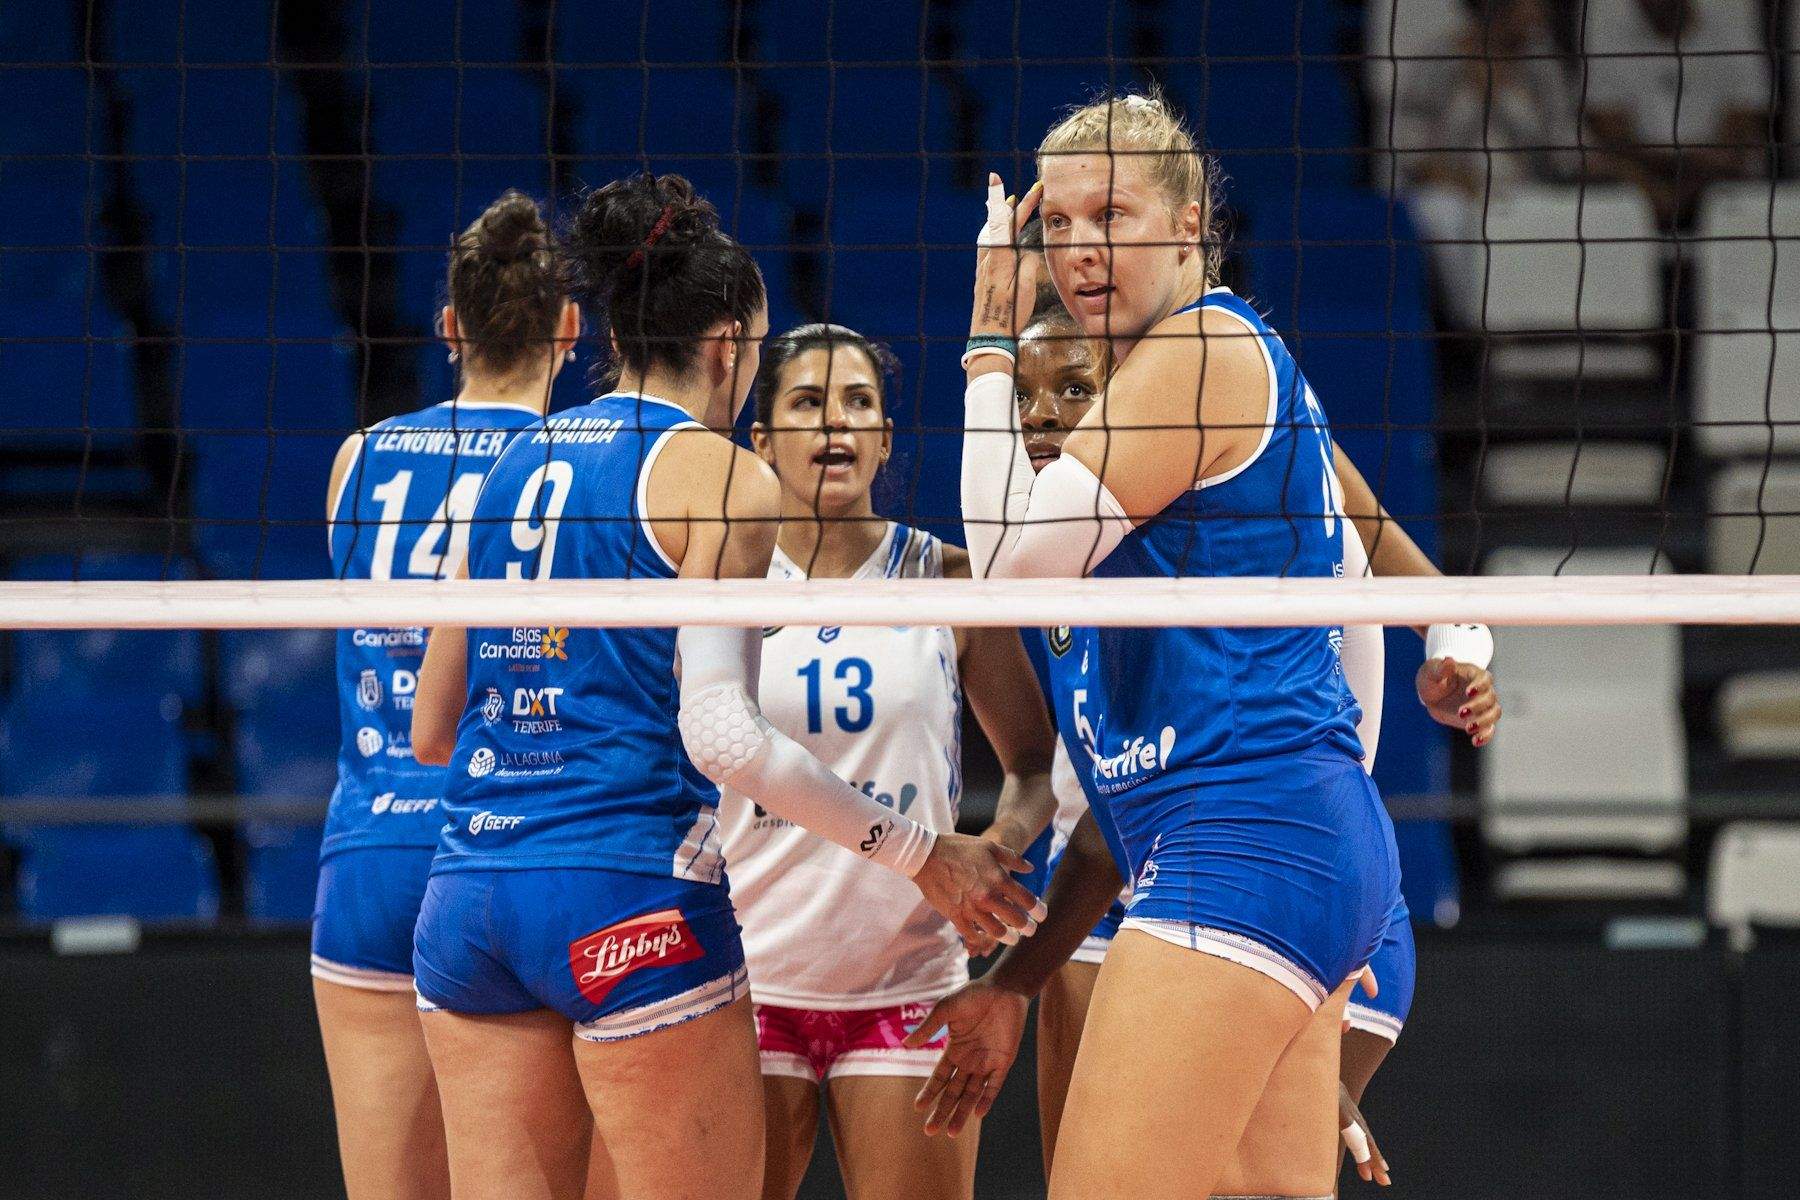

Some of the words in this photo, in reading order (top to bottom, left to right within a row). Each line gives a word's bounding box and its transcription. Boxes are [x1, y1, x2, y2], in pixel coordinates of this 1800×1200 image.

[374, 426, 506, 458] LENGWEILER
[531, 418, 624, 444] ARANDA
[370, 470, 485, 579] 14
[506, 460, 573, 579] 9
[512, 626, 542, 642] Islas
[480, 641, 541, 660] Canarias
[513, 687, 564, 716] DXT
[797, 656, 875, 734] 13
[513, 720, 562, 734] TENERIFE
[501, 753, 513, 766] LA
[514, 750, 565, 766] LAGUNA
[484, 815, 525, 830] GEFF
[579, 923, 682, 984] Libby's
